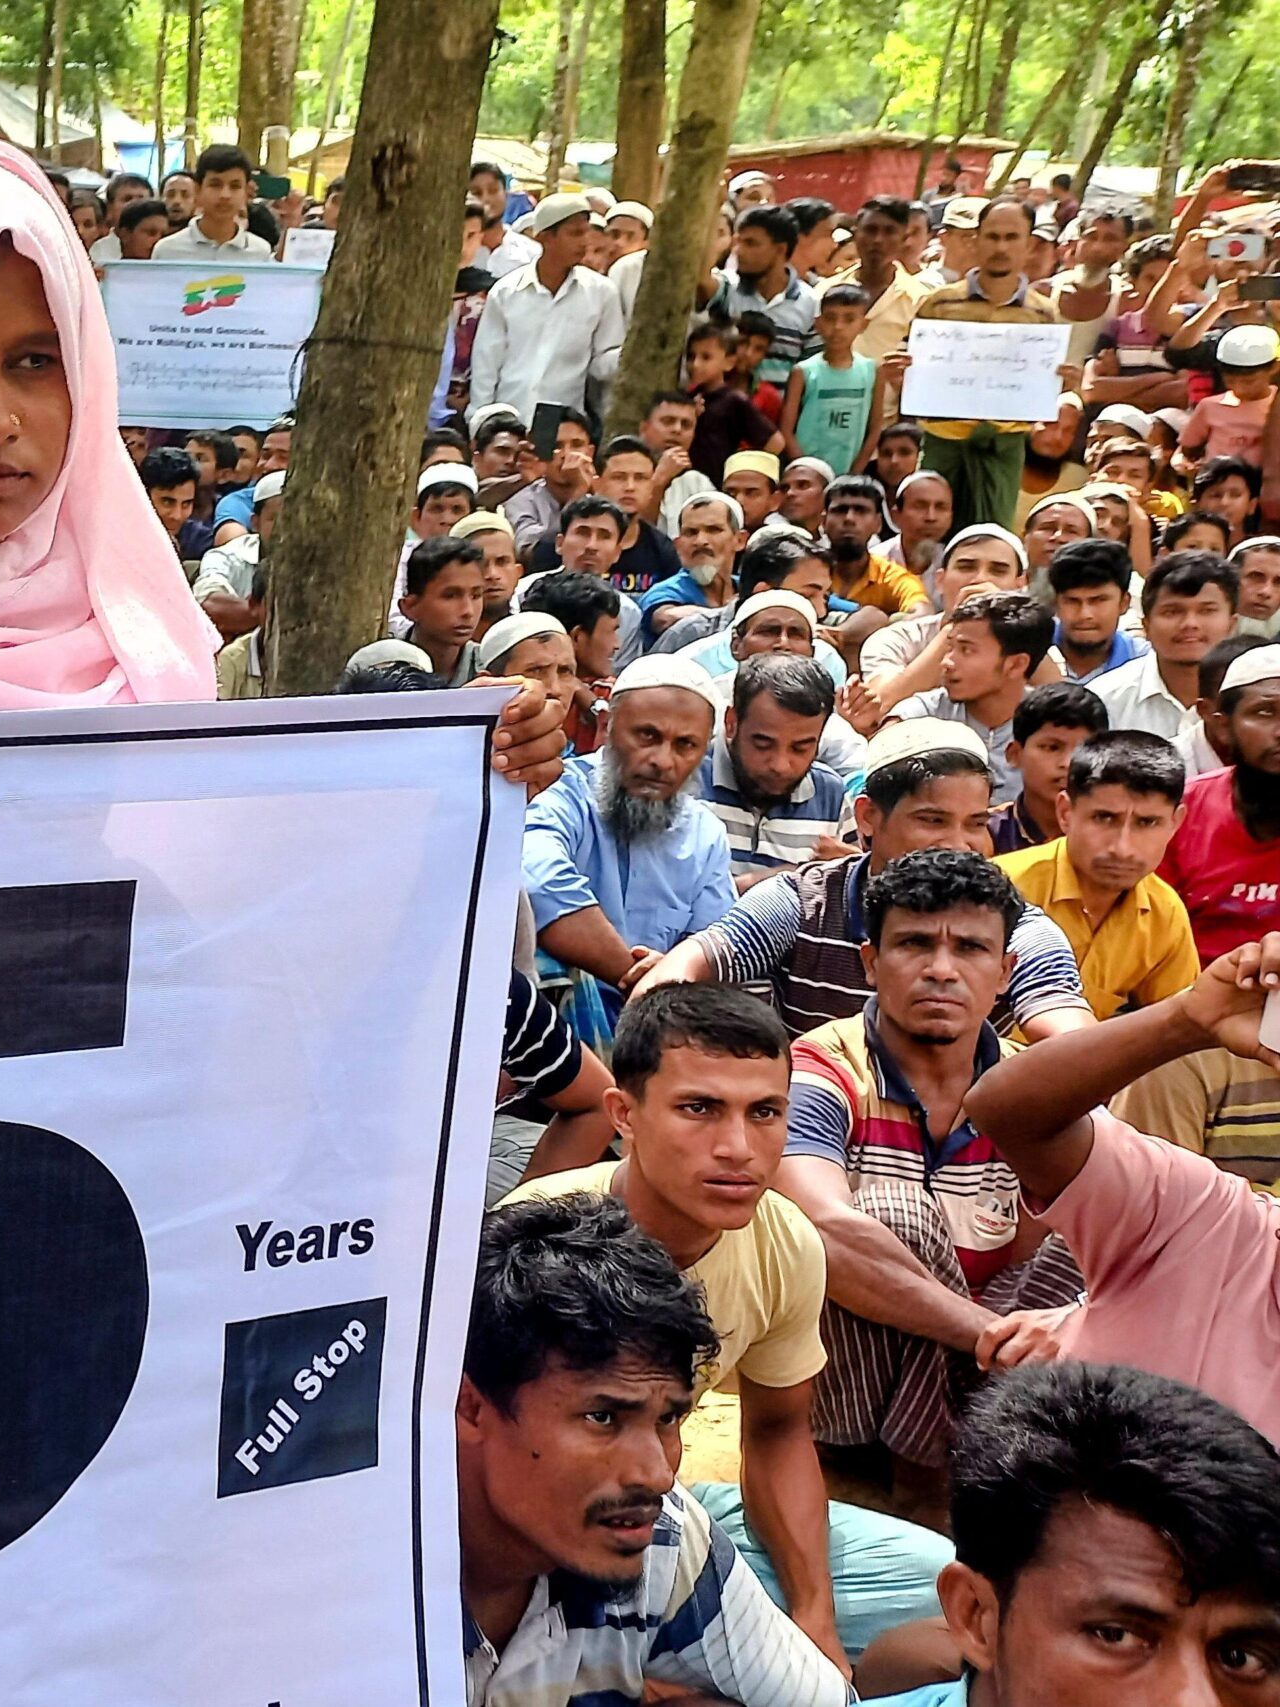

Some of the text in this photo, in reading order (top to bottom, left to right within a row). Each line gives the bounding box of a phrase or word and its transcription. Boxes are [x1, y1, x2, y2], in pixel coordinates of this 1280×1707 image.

[235, 1218, 376, 1272] Years
[235, 1319, 367, 1475] Full Stop
